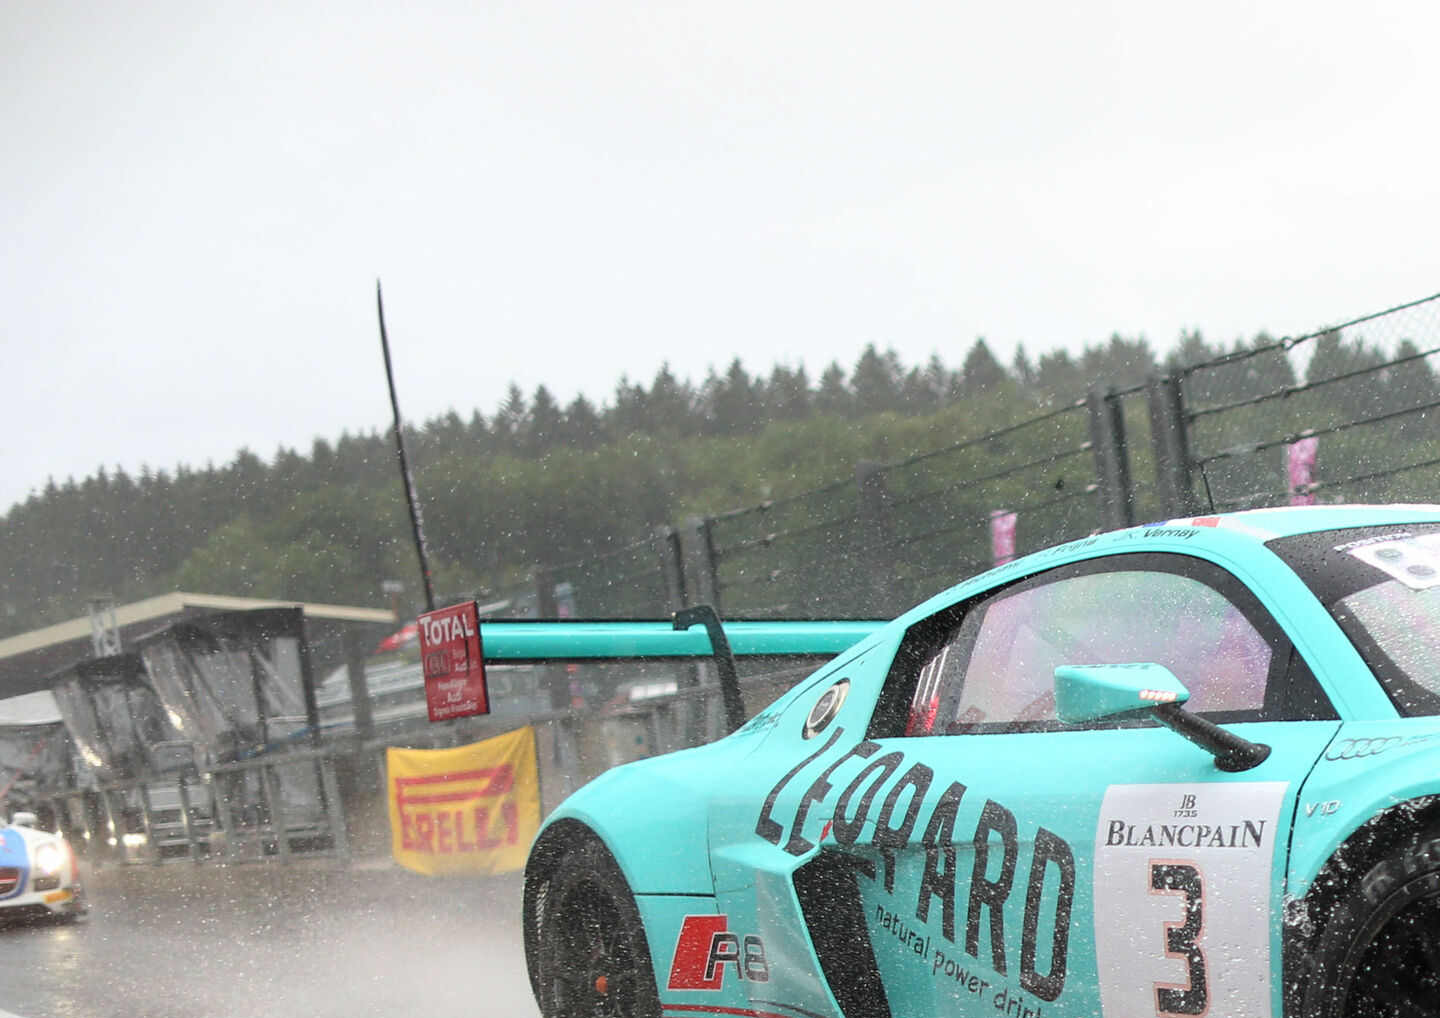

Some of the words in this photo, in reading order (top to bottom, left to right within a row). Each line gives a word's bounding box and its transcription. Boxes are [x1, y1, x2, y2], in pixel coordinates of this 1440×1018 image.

[419, 613, 475, 648] TOTAL
[1305, 800, 1341, 818] V10
[1104, 819, 1268, 849] BLANCPAIN
[754, 726, 1077, 1002] LEOPARD
[703, 931, 770, 984] R8
[874, 902, 930, 960] natural
[931, 950, 990, 999] power
